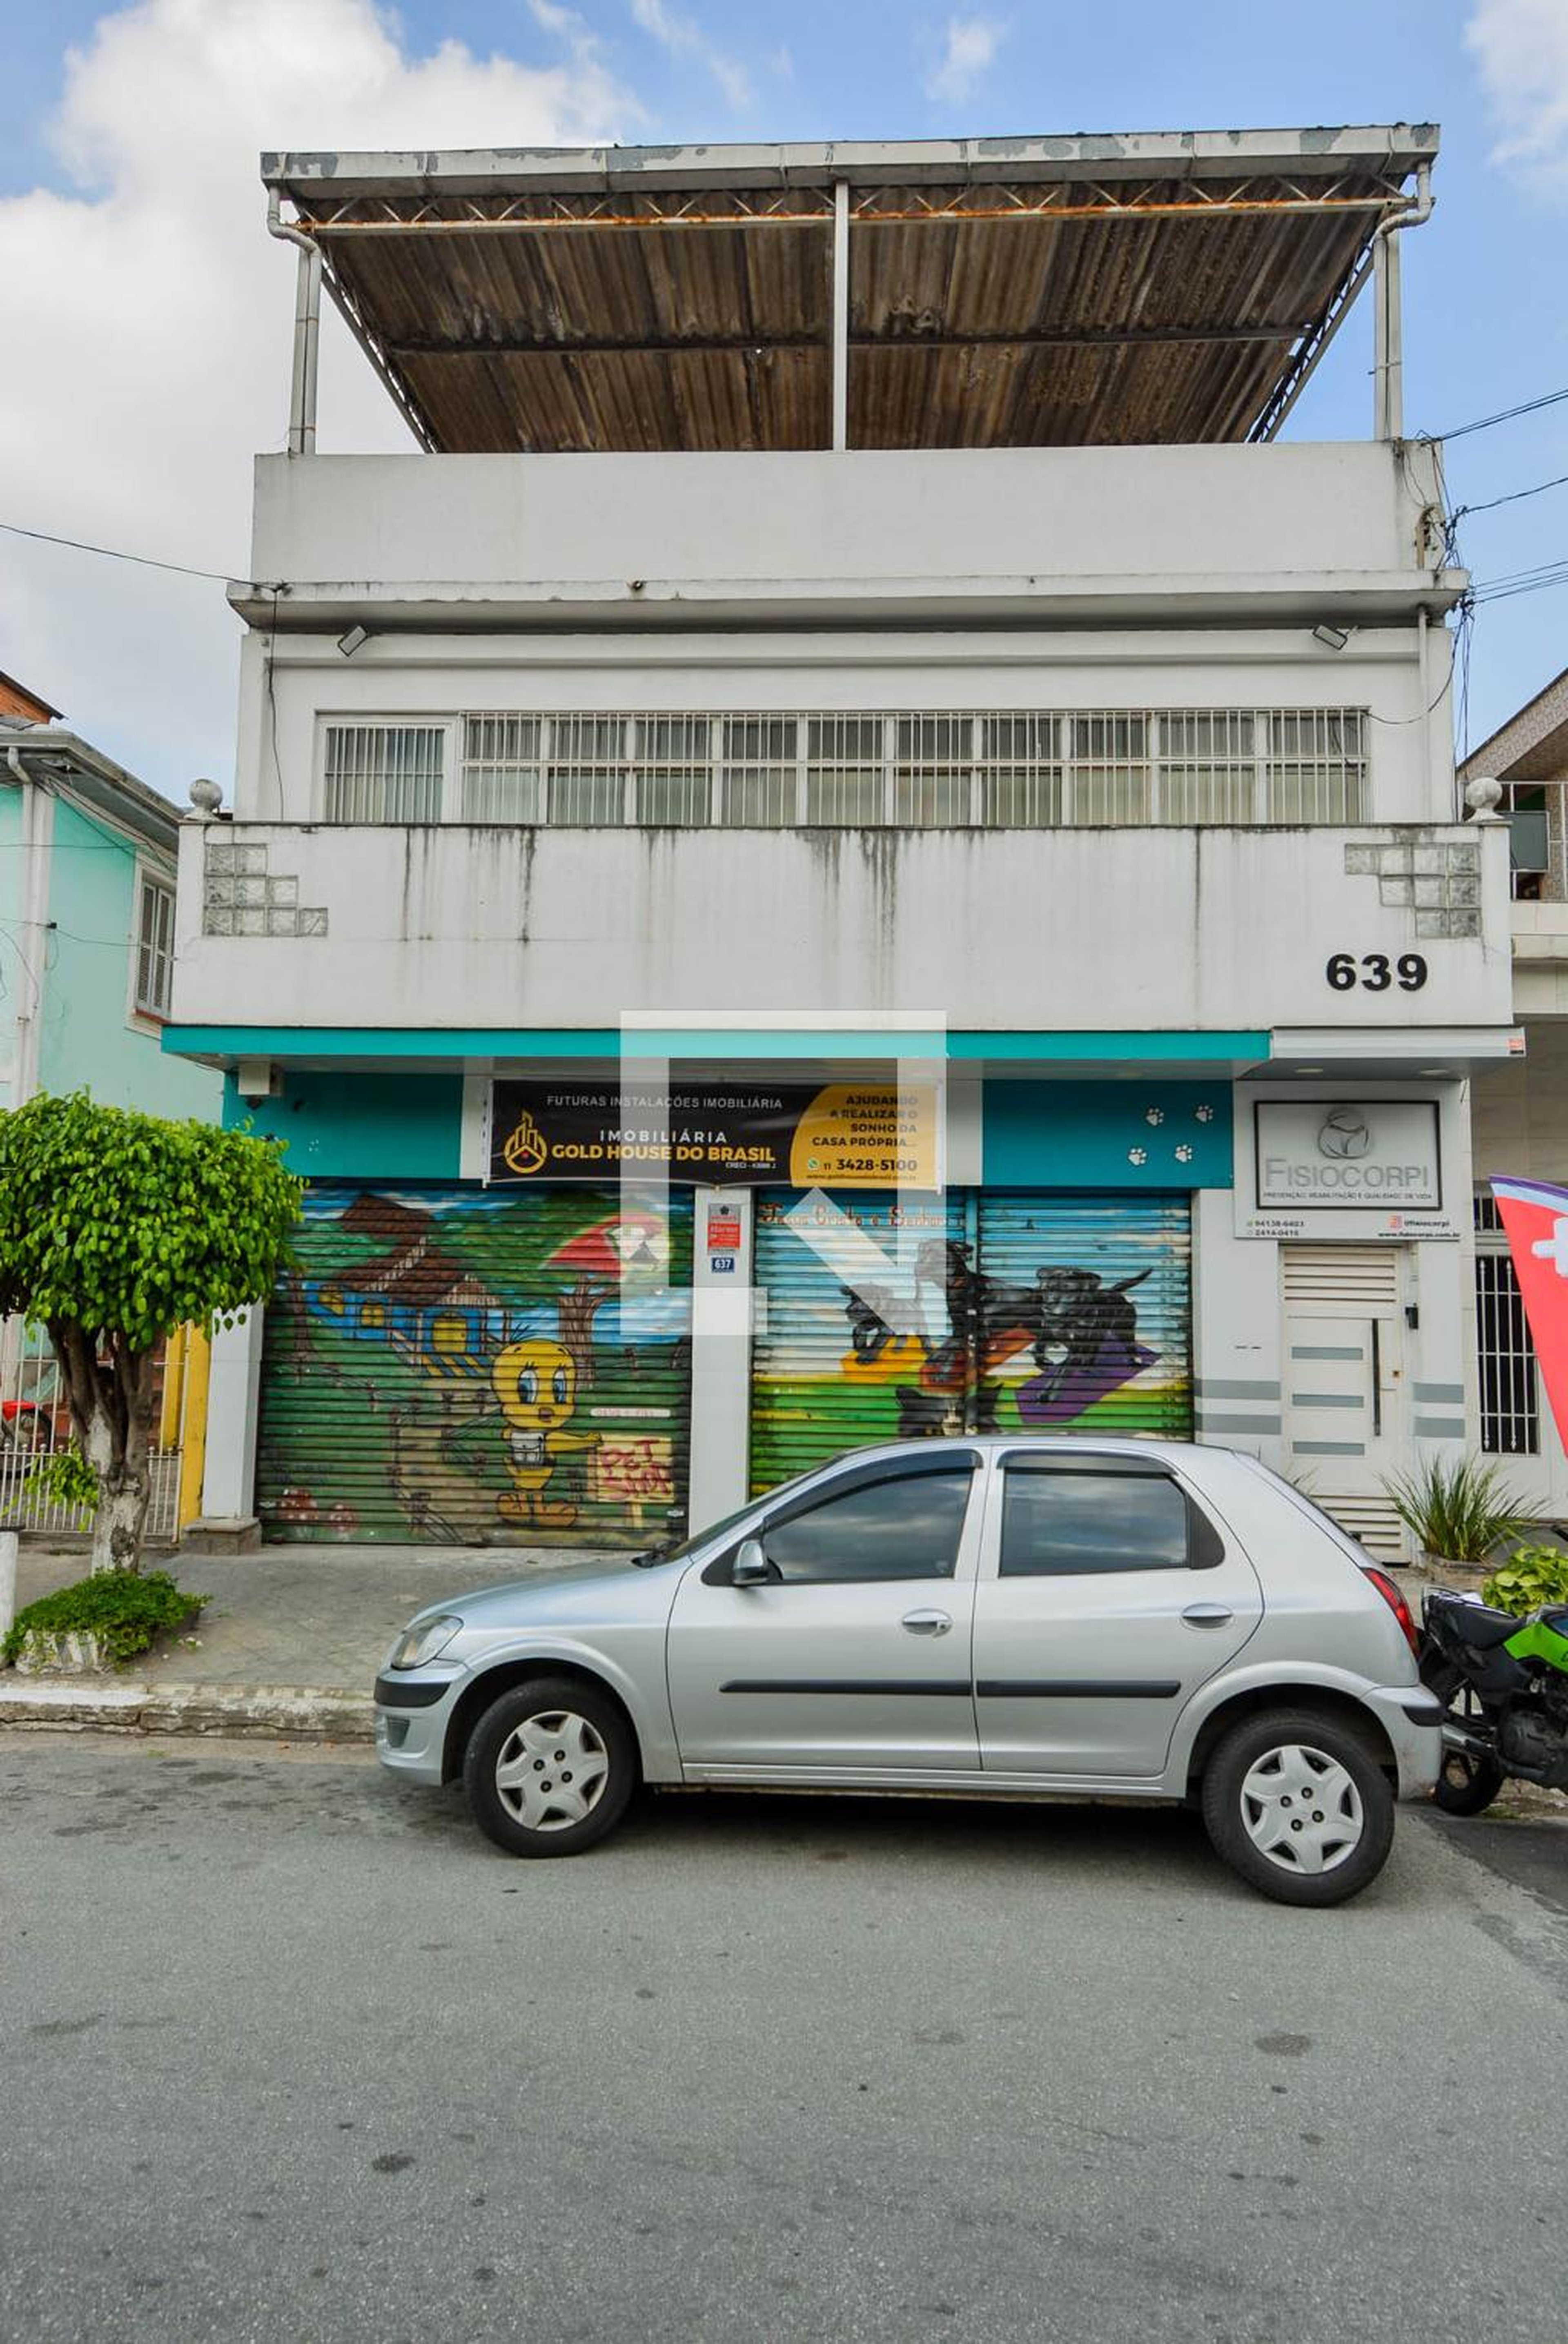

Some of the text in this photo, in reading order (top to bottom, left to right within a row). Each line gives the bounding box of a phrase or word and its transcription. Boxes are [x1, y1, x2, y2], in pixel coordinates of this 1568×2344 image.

[1327, 954, 1428, 991] 639
[547, 1096, 606, 1106] FUTURAS
[704, 1096, 782, 1108] IMOBILIÁRIA
[846, 1096, 918, 1105] AJUDANDO
[842, 1110, 906, 1119] REALIZAR
[851, 1124, 917, 1133] SONHO DA
[600, 1128, 726, 1143] IMOBILIÁRIA
[812, 1137, 847, 1146] CASA
[552, 1144, 775, 1162] GOLD HOUSE DO BRASIL
[837, 1159, 918, 1171] 3428-5100
[715, 1259, 731, 1268] 637
